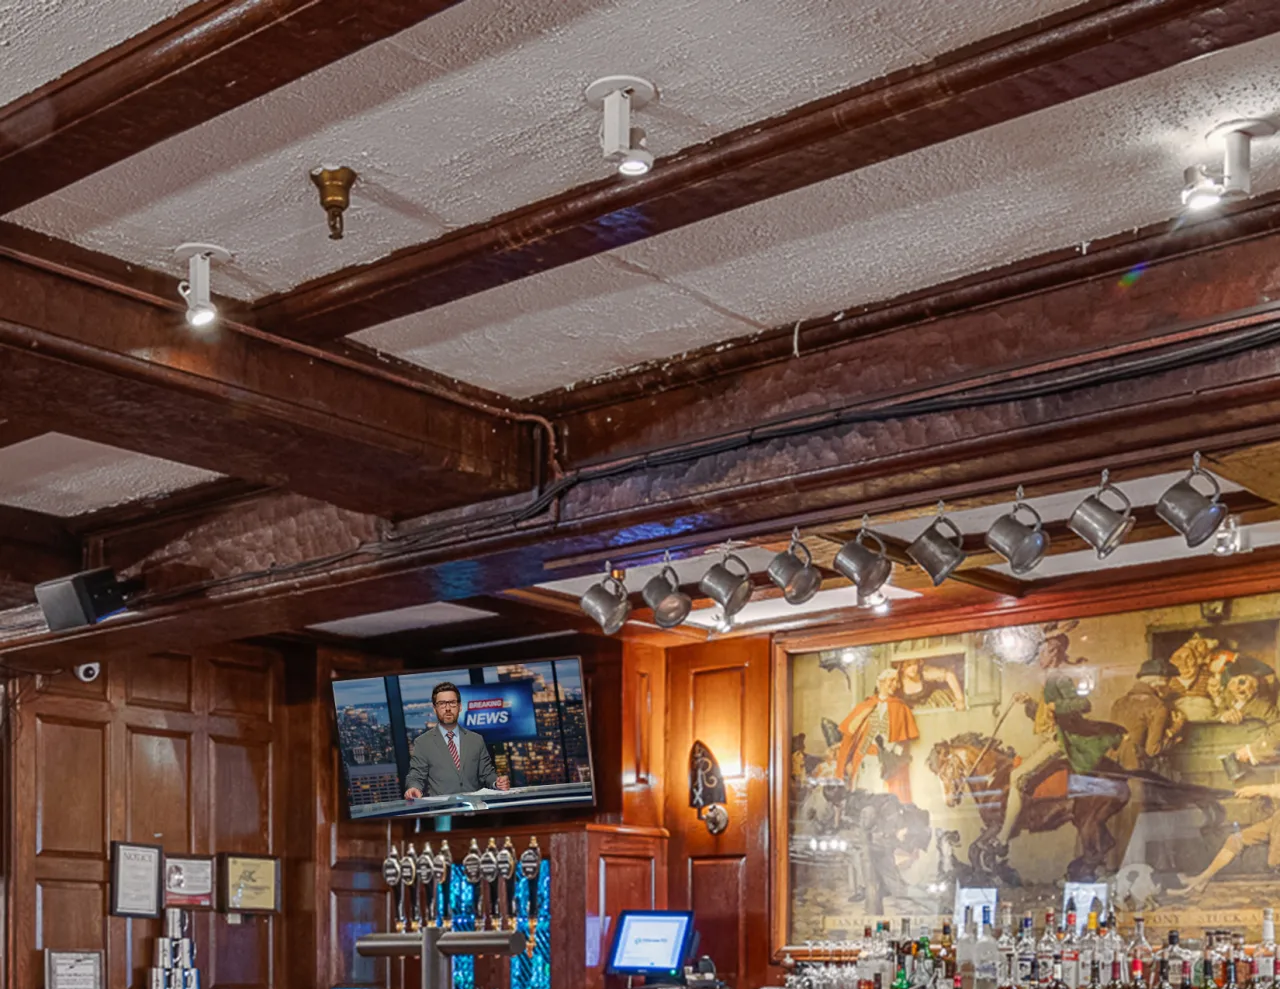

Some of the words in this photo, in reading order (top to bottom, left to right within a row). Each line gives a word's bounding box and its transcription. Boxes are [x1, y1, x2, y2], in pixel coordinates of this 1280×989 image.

[468, 699, 502, 709] BREAKING
[466, 711, 509, 726] NEWS
[692, 787, 704, 806] X
